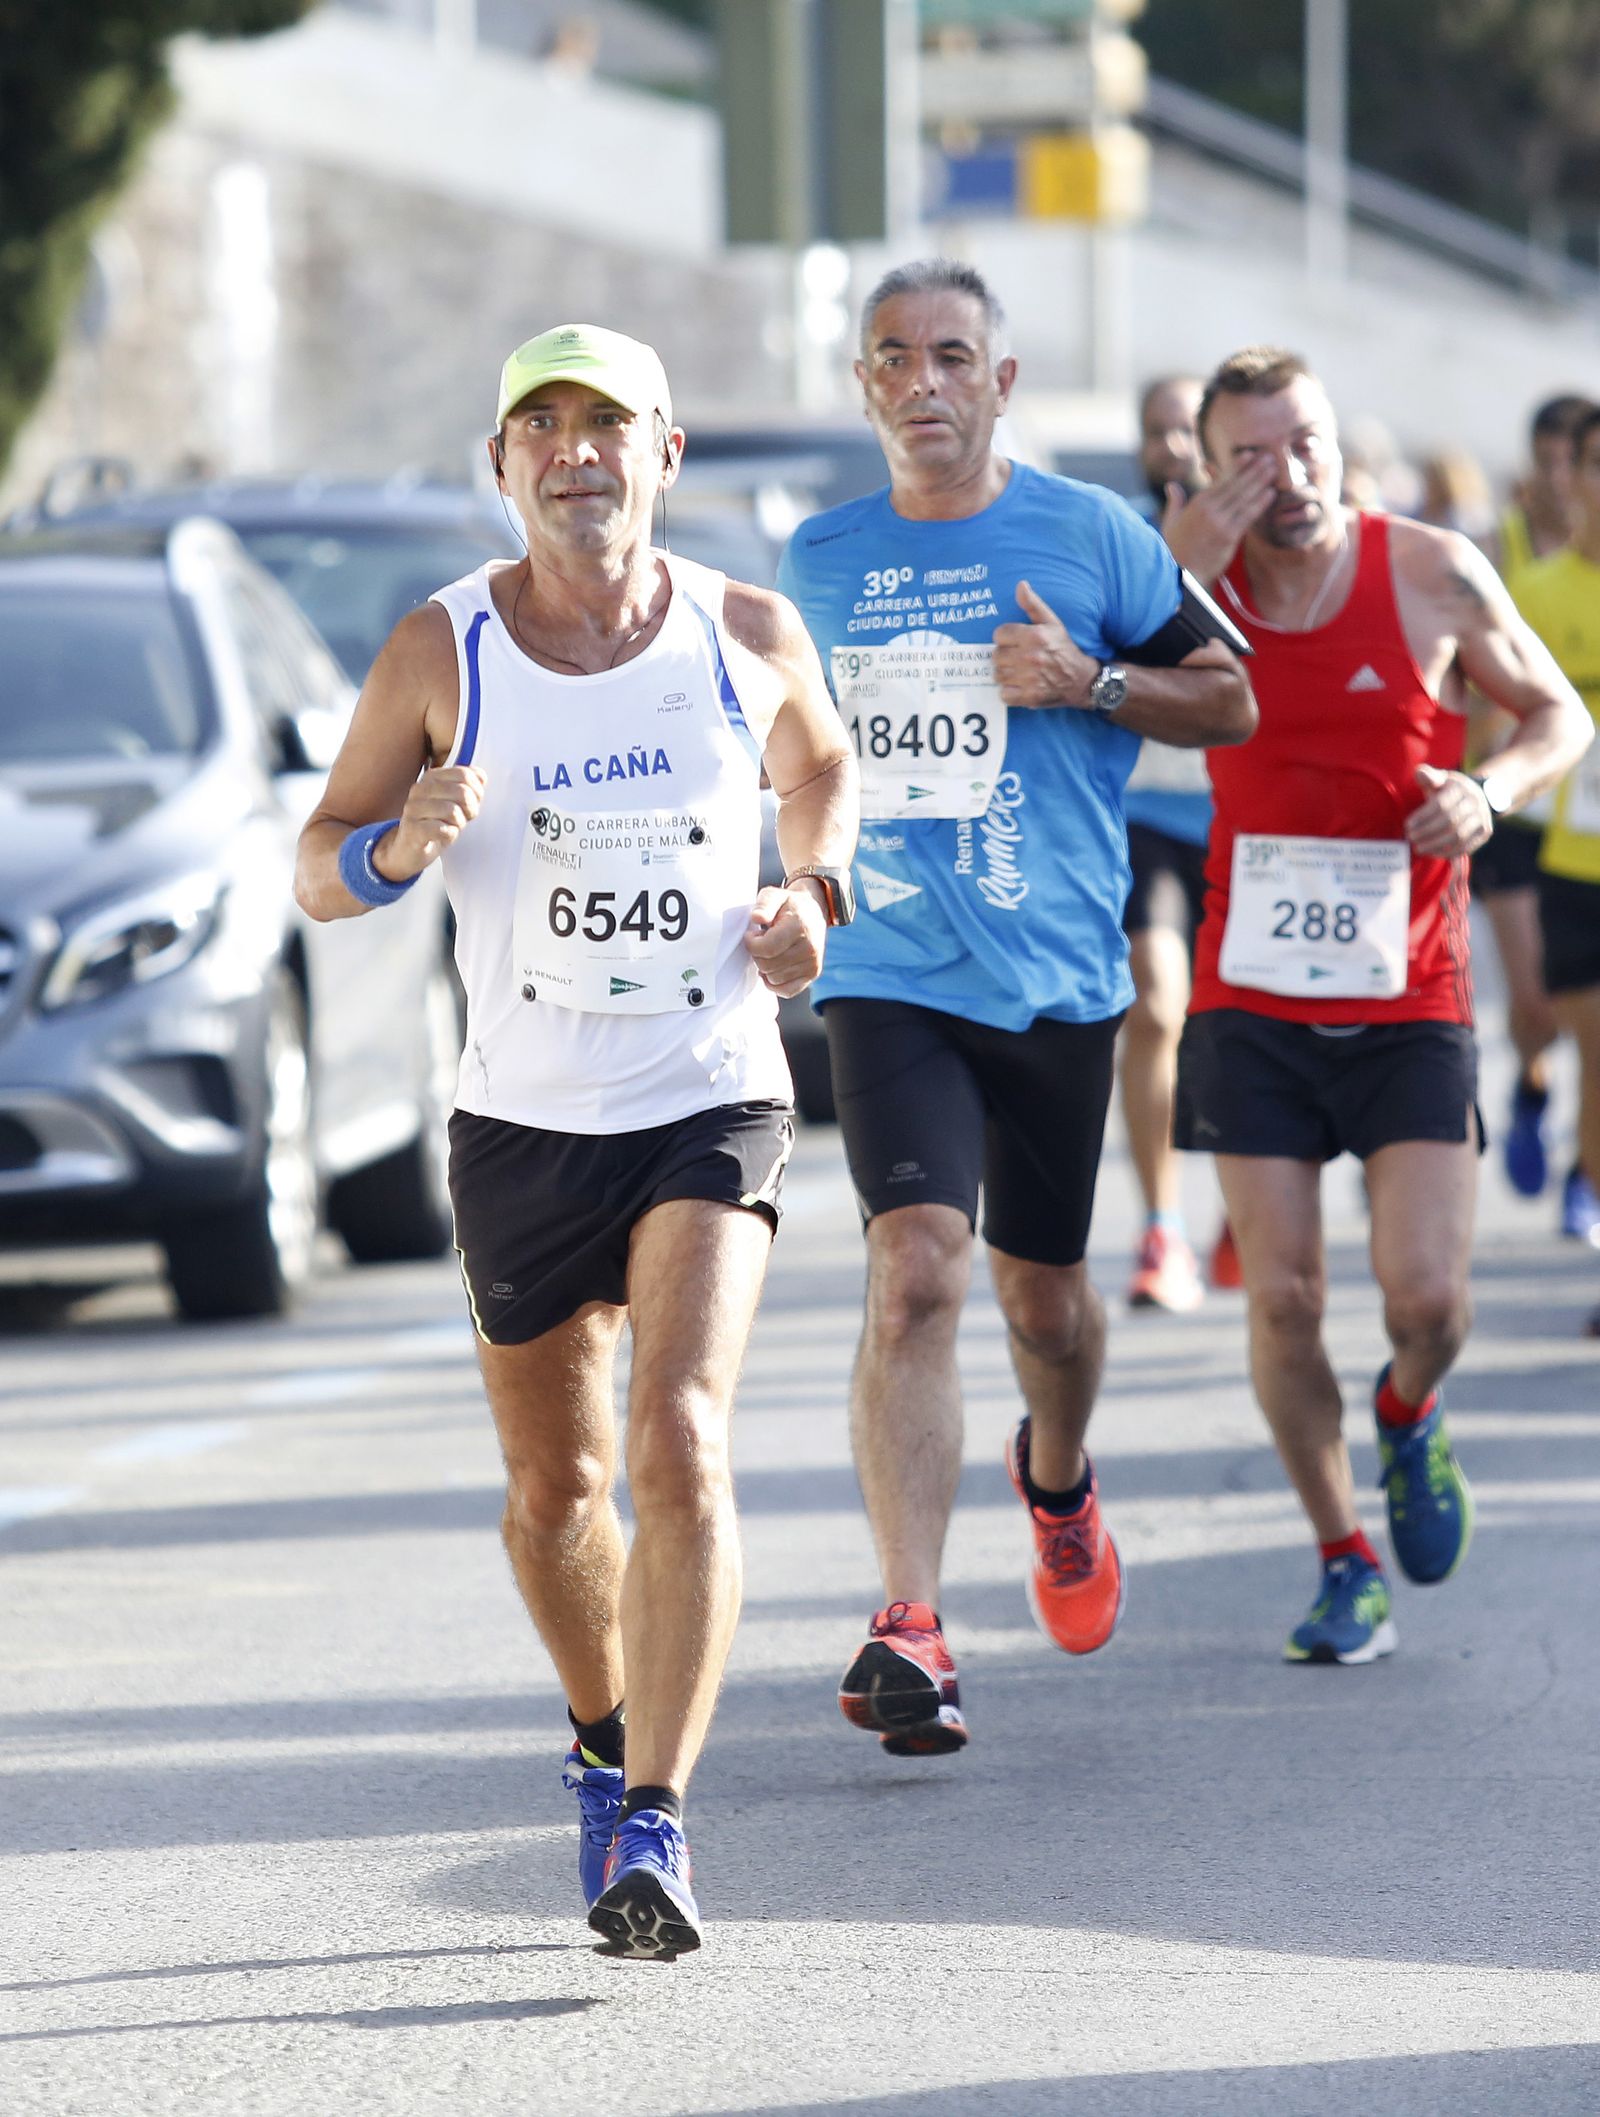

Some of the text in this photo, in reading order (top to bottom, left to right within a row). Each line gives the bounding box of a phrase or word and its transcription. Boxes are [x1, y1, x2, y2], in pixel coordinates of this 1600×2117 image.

[853, 587, 993, 615] CARRERA URBANA
[847, 614, 903, 633] CIUDAD
[907, 612, 929, 628] DE
[851, 713, 990, 759] 18403
[533, 745, 673, 791] LA CAÑA
[586, 815, 708, 831] CARRERA URBANA
[537, 841, 577, 863] RENAULT
[579, 833, 713, 850] CIUDAD DE MÁLAA
[548, 886, 689, 942] 6549
[1271, 899, 1358, 943] 288
[534, 969, 574, 986] RENAULT
